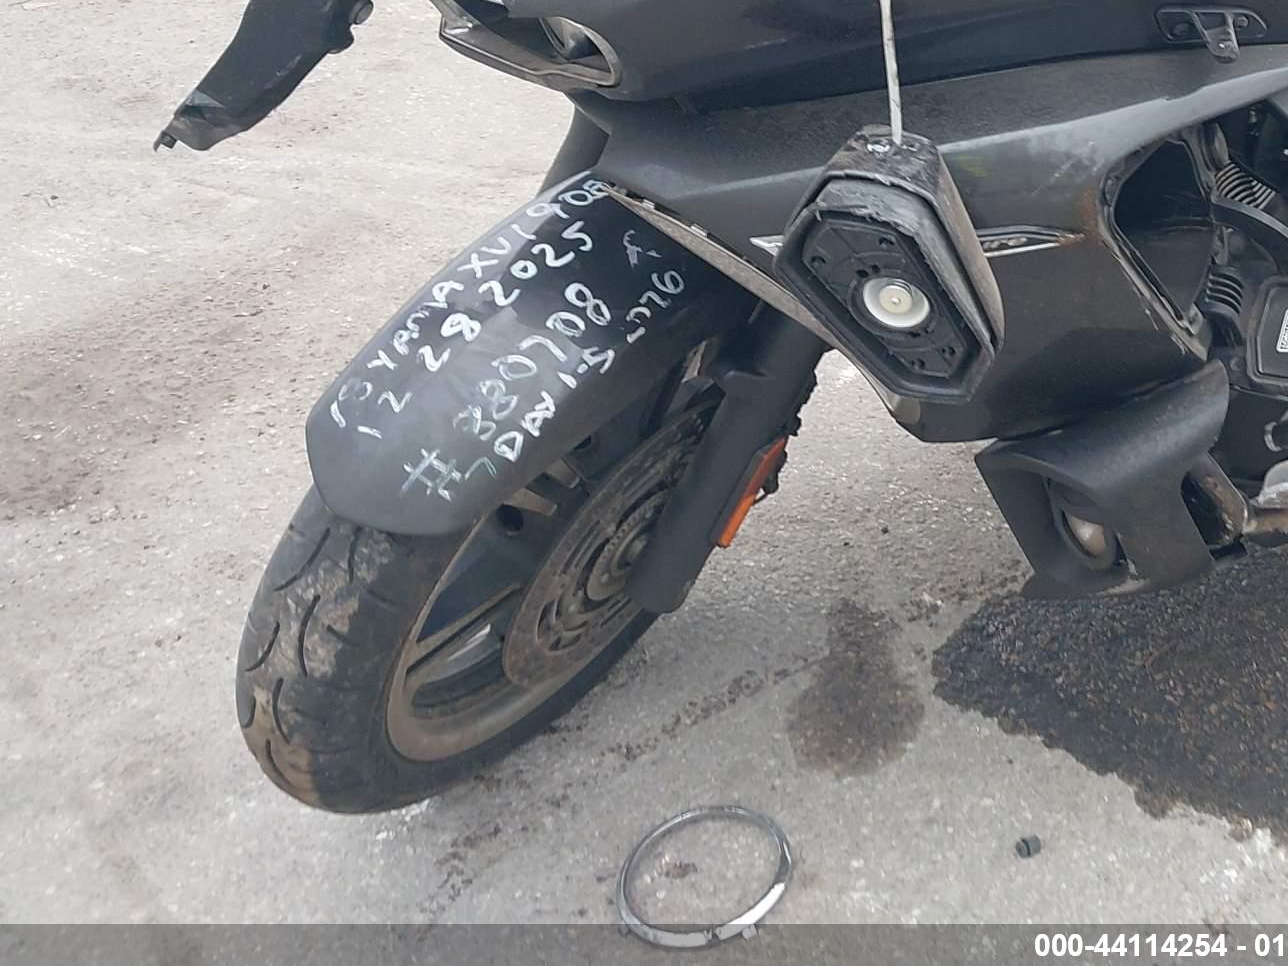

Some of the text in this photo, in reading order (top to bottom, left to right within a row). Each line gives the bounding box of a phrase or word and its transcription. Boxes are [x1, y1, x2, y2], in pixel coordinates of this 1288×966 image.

[358, 220, 593, 439] 12 28 2025
